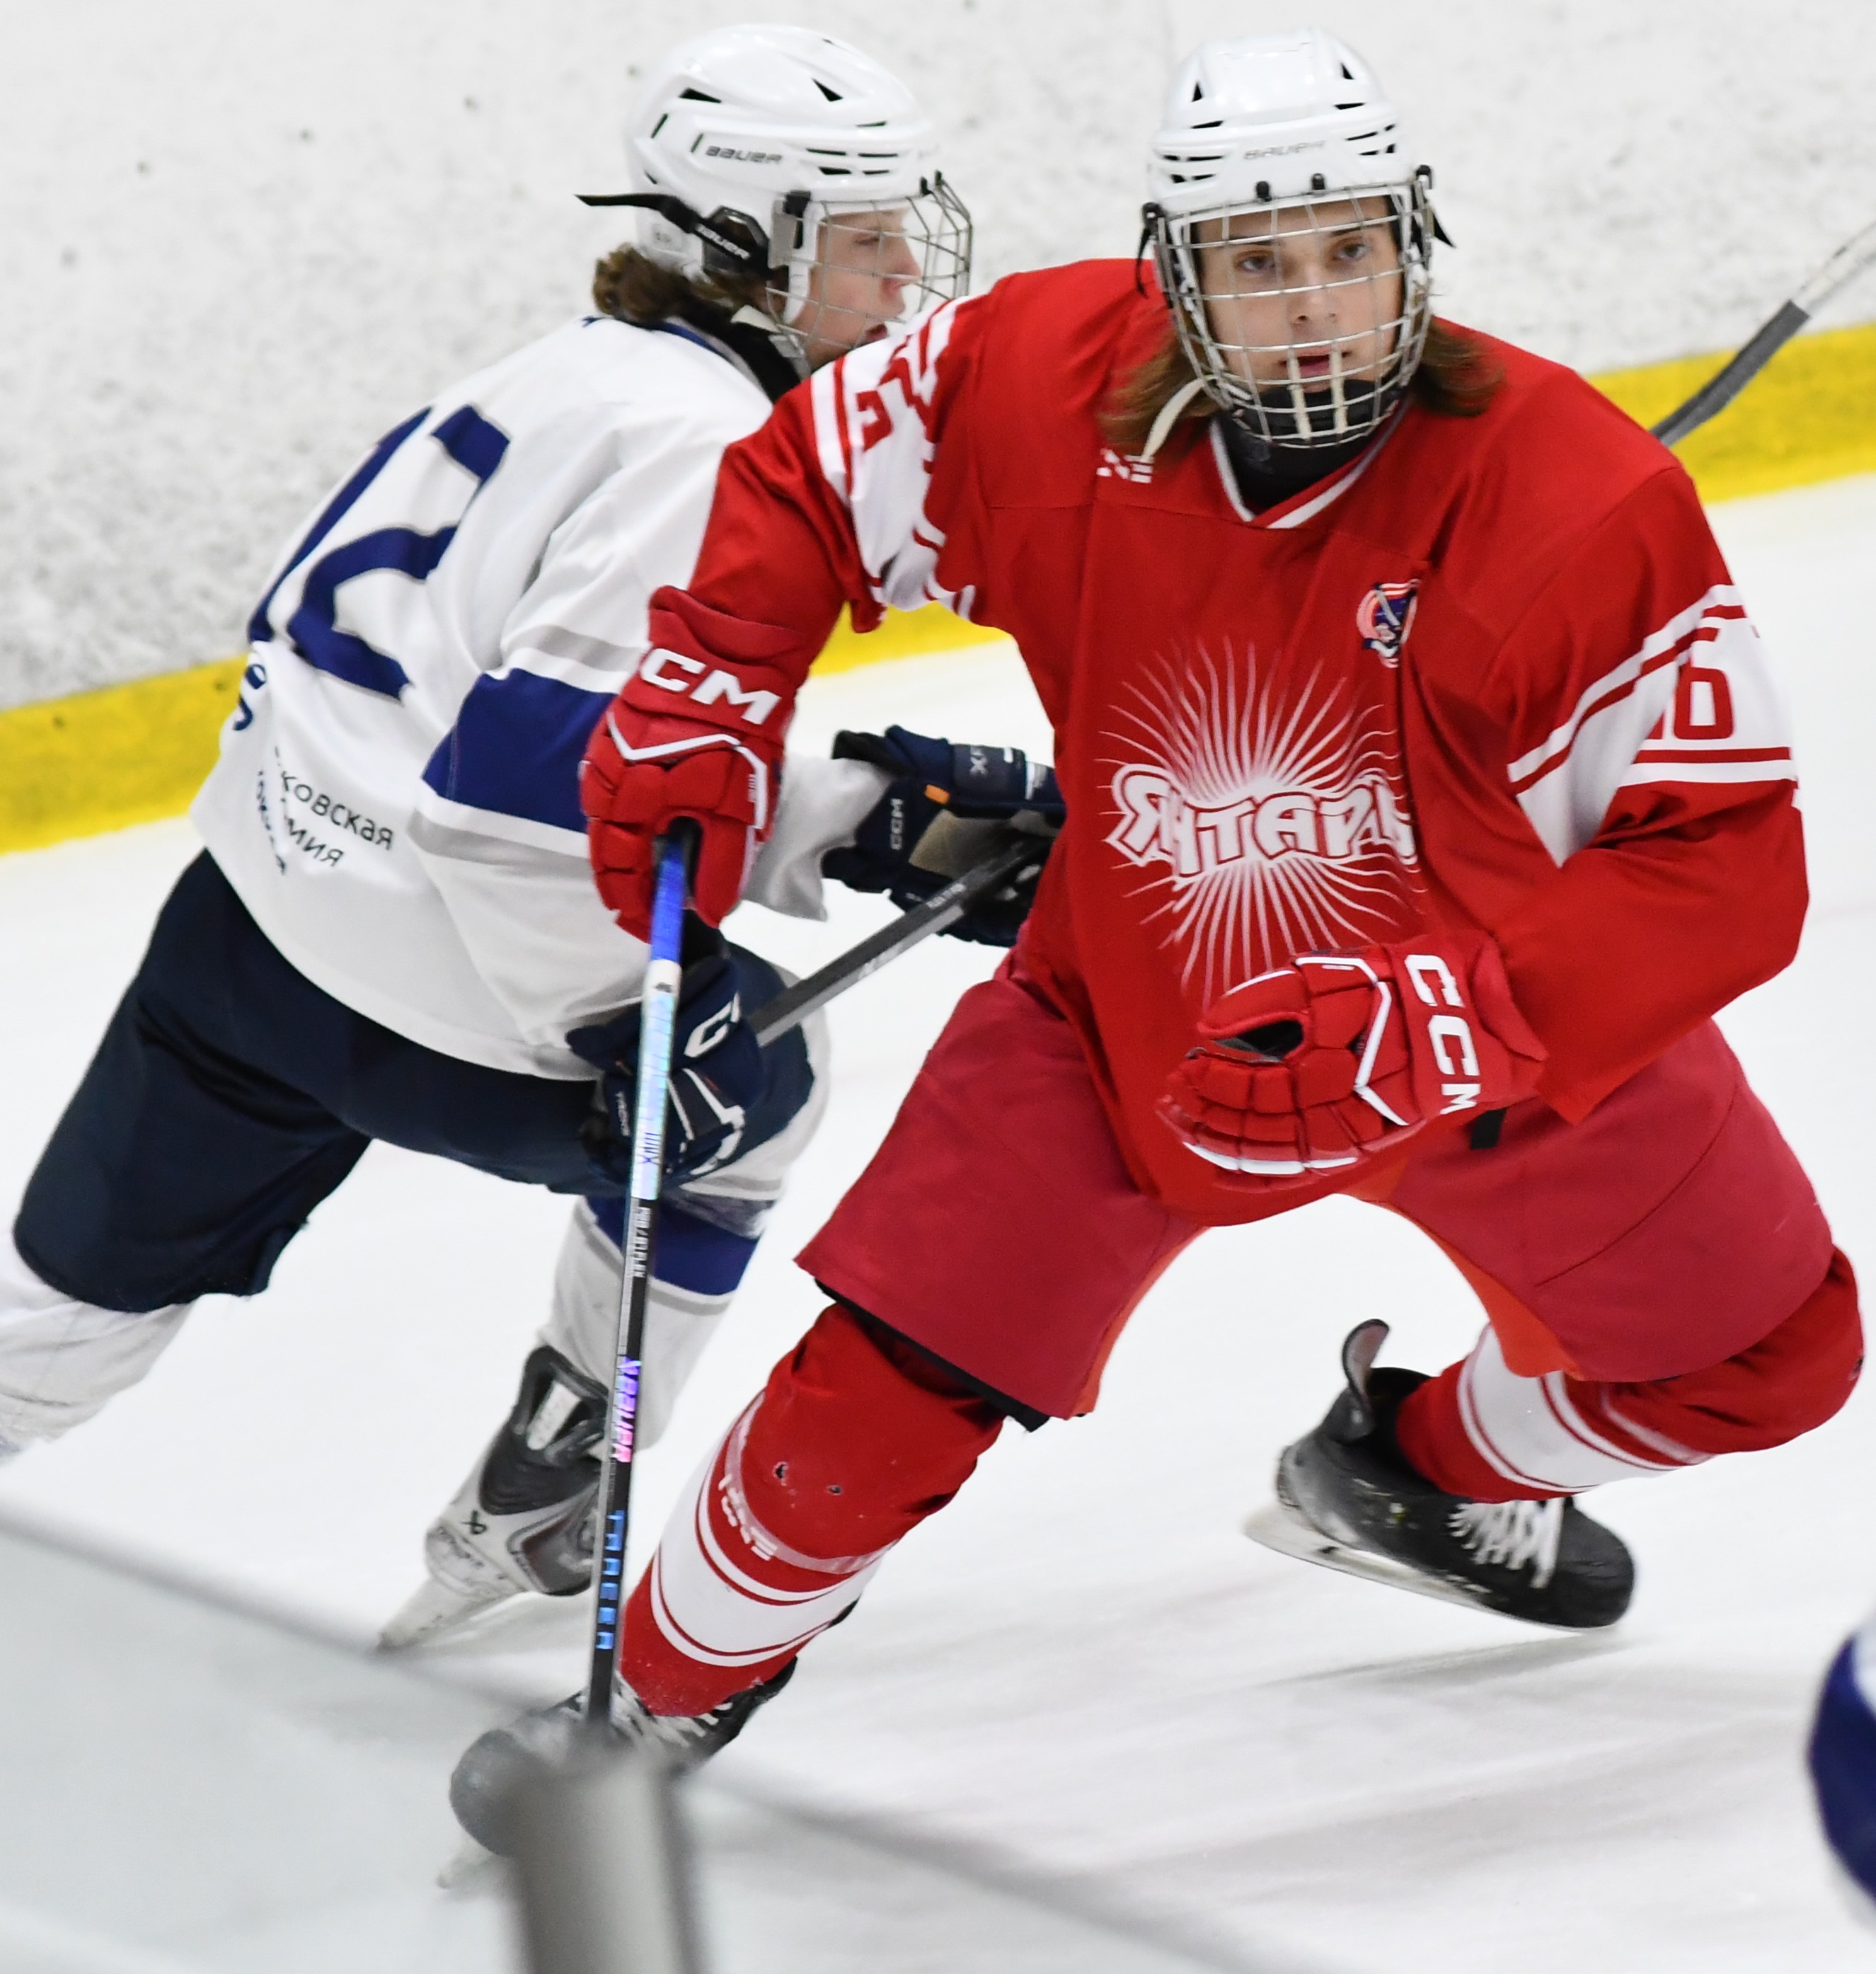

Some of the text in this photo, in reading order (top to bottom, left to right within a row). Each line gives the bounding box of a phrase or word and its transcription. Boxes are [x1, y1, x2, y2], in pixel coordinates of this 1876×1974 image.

[706, 145, 783, 164] BAUER
[275, 763, 394, 851] ковская
[285, 811, 344, 868] мия
[1405, 954, 1482, 1115] CCM
